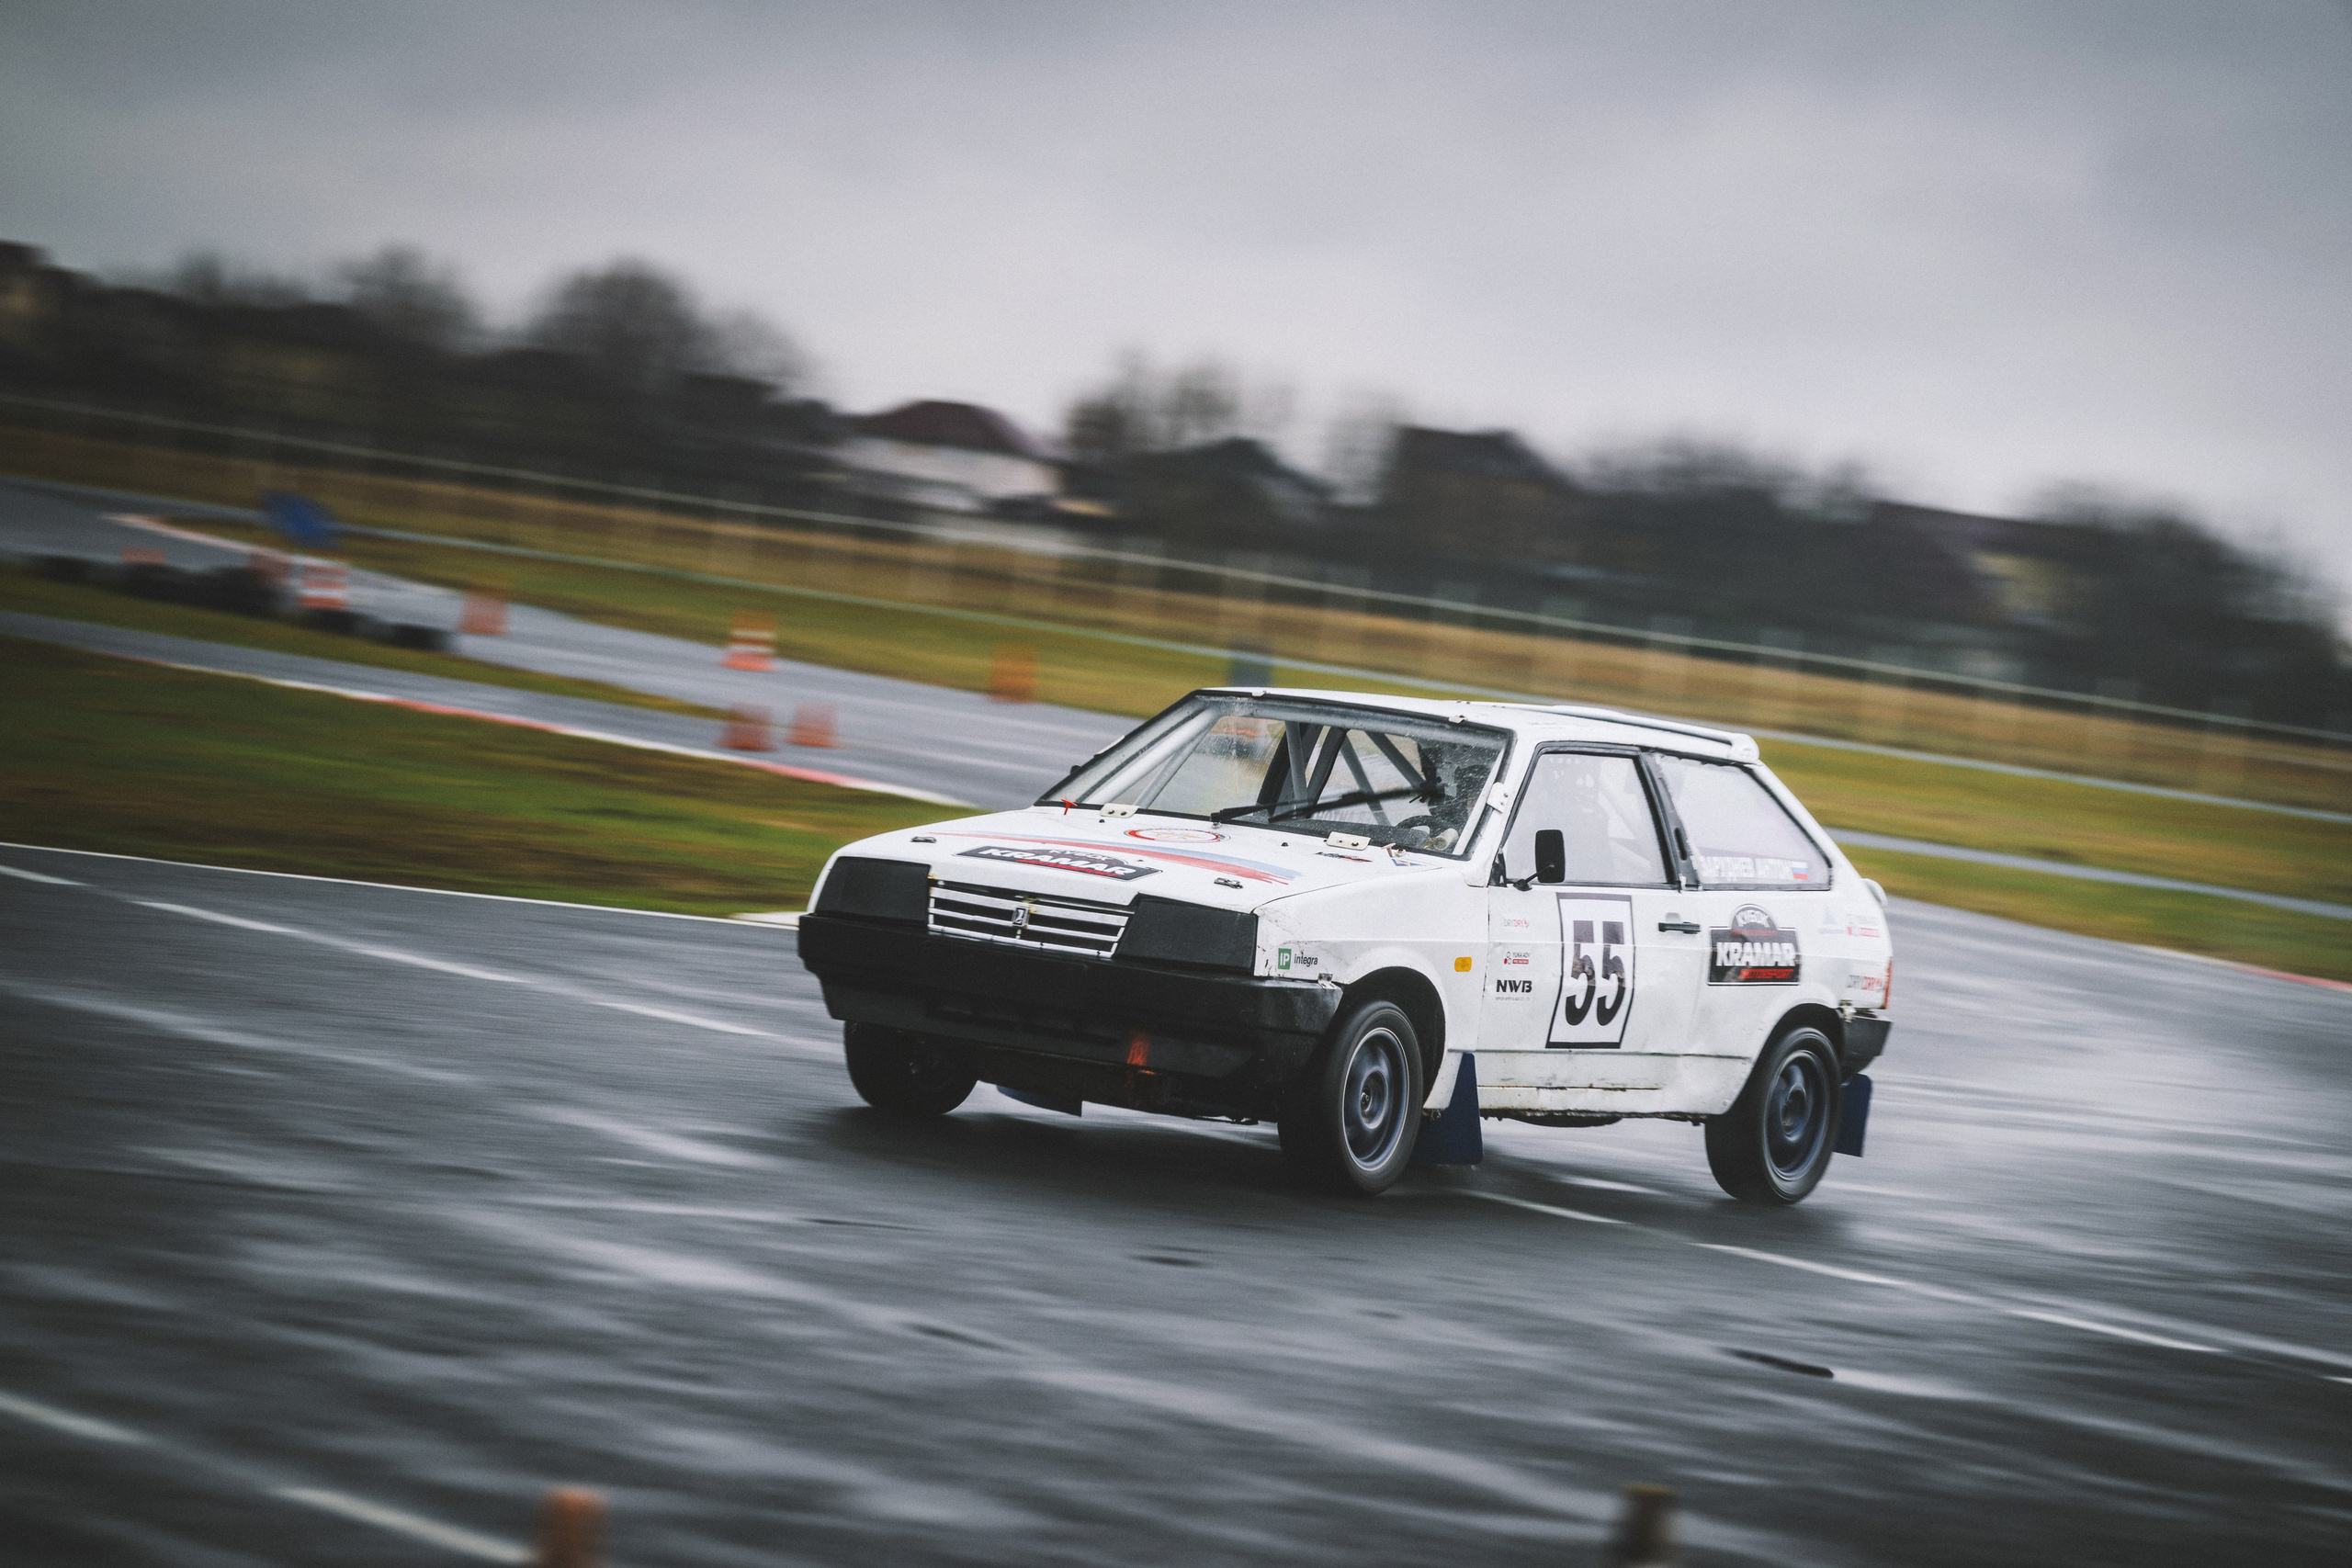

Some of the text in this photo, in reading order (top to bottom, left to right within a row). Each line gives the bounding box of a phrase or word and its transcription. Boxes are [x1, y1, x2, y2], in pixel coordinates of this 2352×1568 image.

[978, 848, 1137, 875] KRAMAR
[1279, 952, 1318, 967] IP integra
[1715, 942, 1798, 967] KRAMAR
[1565, 919, 1626, 1027] 55
[1496, 979, 1533, 994] NWB
